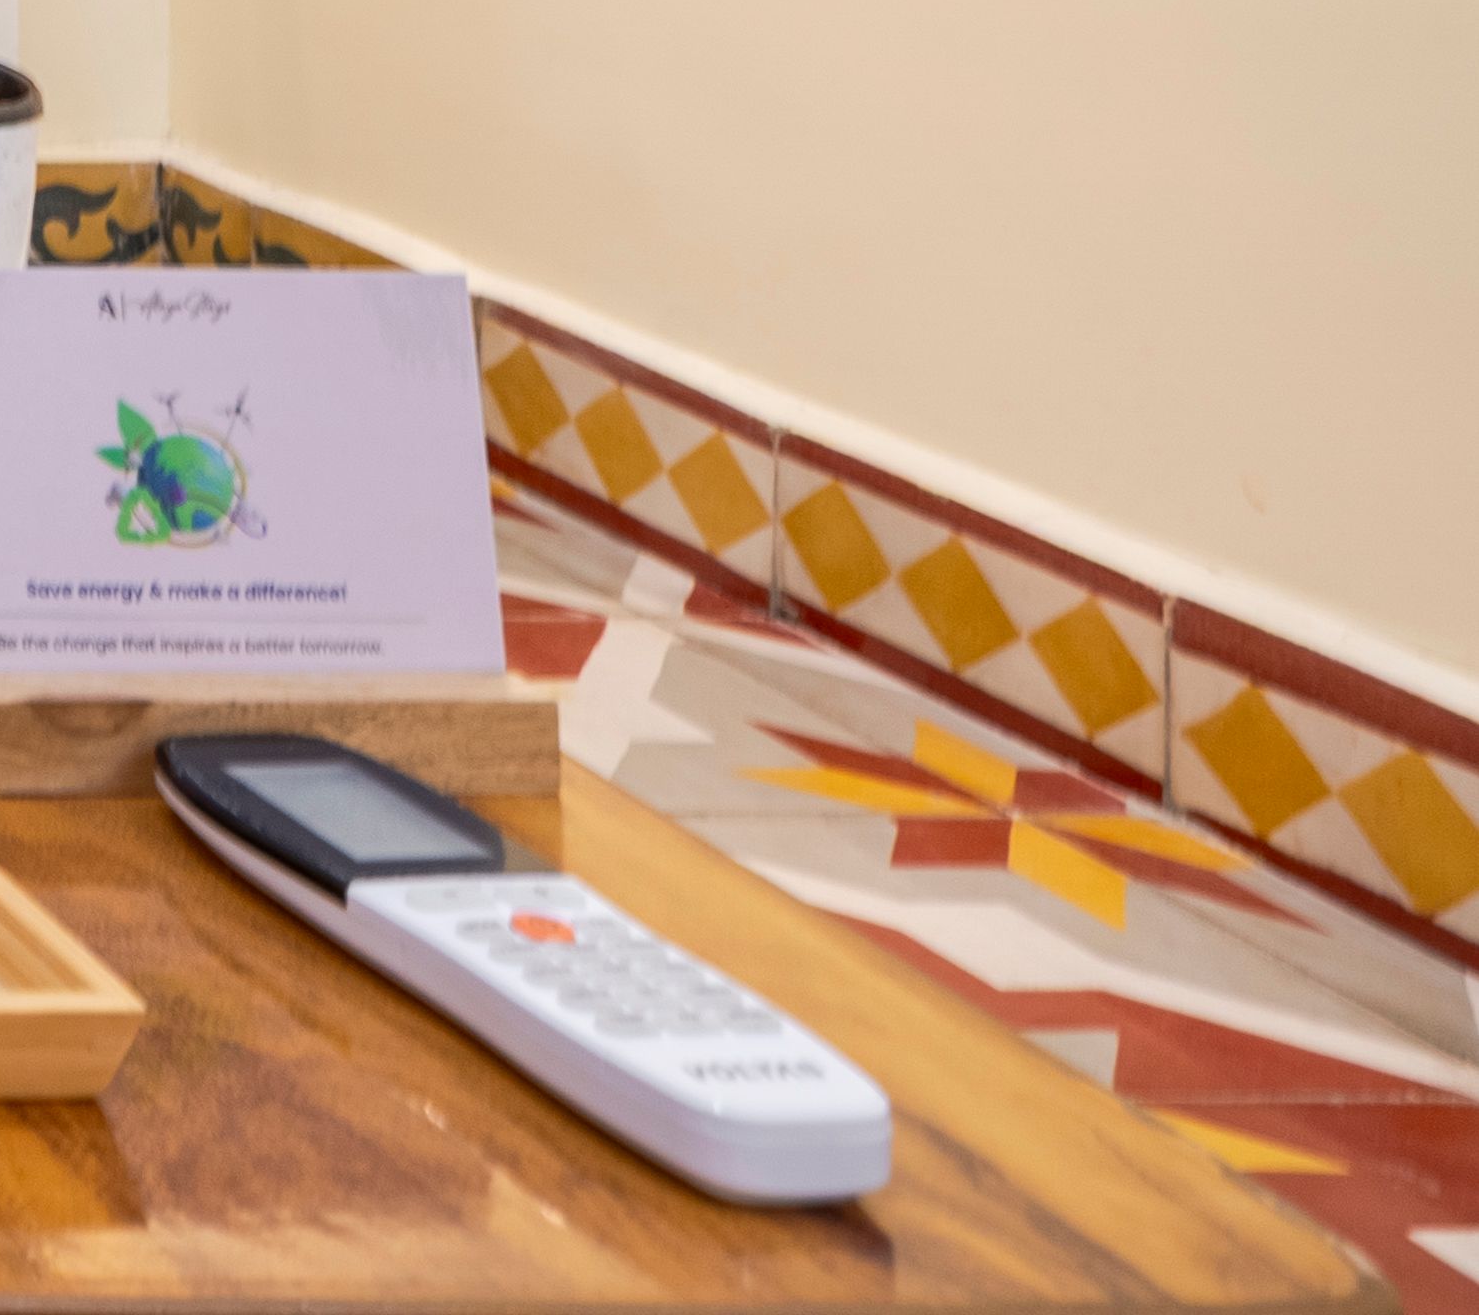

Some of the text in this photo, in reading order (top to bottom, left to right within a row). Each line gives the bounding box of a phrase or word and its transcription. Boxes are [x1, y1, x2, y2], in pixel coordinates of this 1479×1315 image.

[26, 580, 73, 600] Save
[77, 582, 144, 605] energy
[167, 582, 223, 602] make
[227, 585, 240, 602] a
[244, 581, 348, 603] difference!
[21, 633, 49, 653] the
[53, 633, 118, 657] change
[121, 633, 156, 654] that
[160, 635, 225, 658] inspires
[228, 639, 240, 655] a
[244, 635, 294, 656] better
